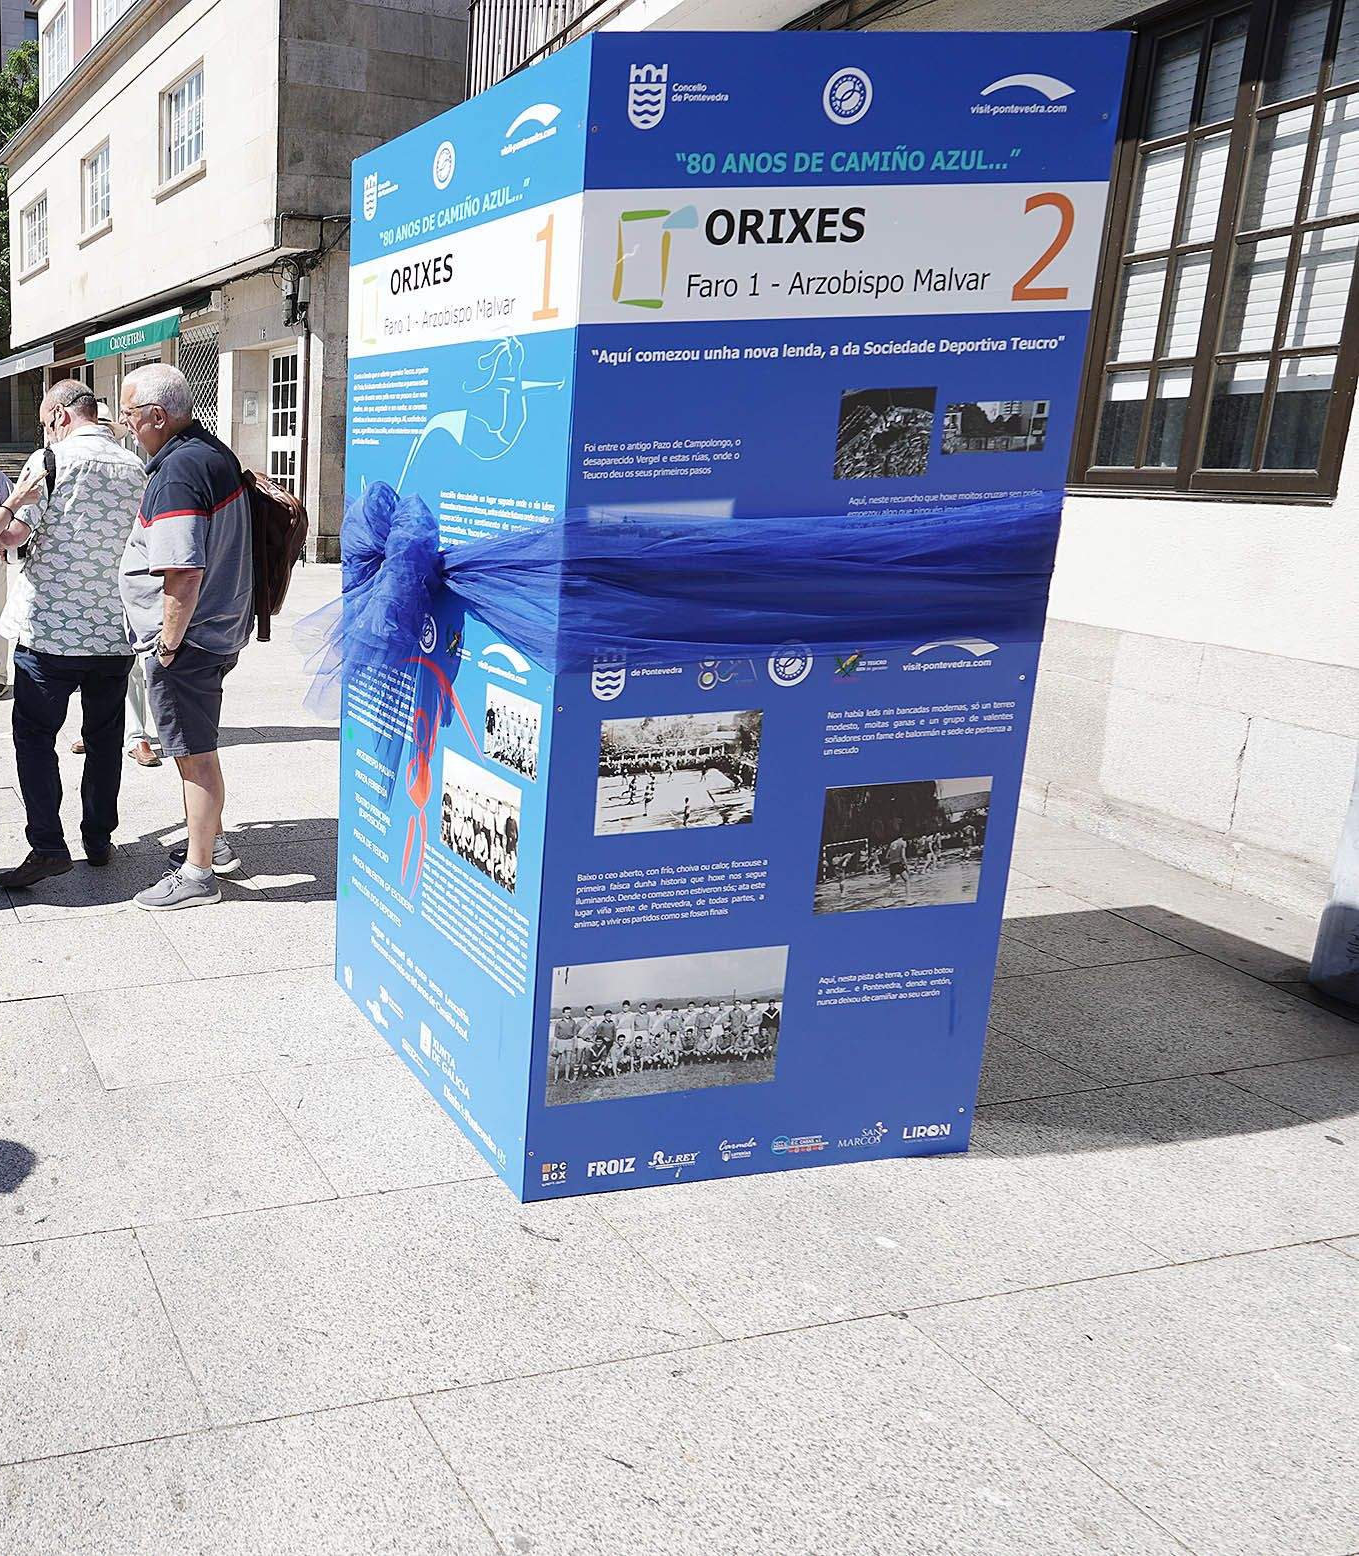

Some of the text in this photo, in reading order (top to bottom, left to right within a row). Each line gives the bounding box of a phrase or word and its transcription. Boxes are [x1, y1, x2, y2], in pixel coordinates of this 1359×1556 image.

[672, 83, 707, 92] Concello
[671, 93, 729, 102] de Pontevedra
[970, 104, 1067, 116] visit-pontevedra.com
[722, 152, 787, 173] ANOS
[793, 152, 825, 173] DE
[830, 145, 925, 172] CAMIÑO
[395, 220, 421, 244] ANOS
[422, 213, 436, 233] DE
[437, 195, 480, 228] CAMIÑO
[704, 206, 866, 246] ORIXES
[1011, 191, 1075, 302] 2
[390, 253, 453, 295] ORIXES
[532, 213, 559, 321] 1
[686, 274, 738, 299] Faro
[749, 273, 760, 296] 1
[788, 270, 904, 300] Arzobispo
[914, 267, 991, 292] Malvar
[383, 296, 516, 336] Faro 1 Arzobispo Malvar
[635, 349, 700, 362] comezou
[704, 345, 739, 360] unha
[744, 346, 779, 359] nova
[783, 343, 826, 359] lenda,
[830, 345, 838, 356] a
[842, 342, 859, 356] da
[863, 339, 936, 356] Sociedade
[939, 337, 1007, 355] Deportiva
[584, 443, 596, 452] Foi
[597, 444, 619, 452] entre
[626, 442, 651, 452] antigo
[652, 441, 671, 450] Pazo
[672, 440, 683, 449] de
[683, 439, 733, 449] Campolongo,
[583, 456, 634, 467] desaparecido
[636, 454, 660, 465] Vergel
[669, 454, 690, 462] estas
[691, 452, 711, 462] rúas,
[712, 452, 732, 461] onde
[582, 467, 712, 480] Teucro deu os seus primeiros pasos
[848, 495, 867, 506] Aquí,
[868, 496, 889, 504] neste
[890, 494, 923, 503] recuncho
[924, 495, 939, 503] que
[940, 493, 957, 501] hoxe
[958, 492, 983, 500] moitos
[983, 491, 1008, 499] cruzan
[1009, 490, 1022, 498] sen
[630, 667, 683, 677] de Pontevedra
[902, 658, 992, 673] visit-pontevedra.com
[827, 701, 1016, 719] Non había leds nin bancadas modernas, só un terreo
[825, 723, 860, 731] modesto,
[864, 720, 889, 729] moitas
[893, 718, 916, 728] ganas
[942, 716, 965, 725] grupo
[968, 714, 979, 722] de
[983, 713, 1014, 721] valentes
[823, 746, 859, 756] un escudo
[577, 873, 597, 882] Baixo
[604, 872, 618, 880] ceo
[619, 869, 645, 879] aberto,
[645, 868, 660, 876] con
[660, 866, 675, 875] frío,
[676, 864, 699, 873] choiva
[700, 863, 710, 871] ou
[711, 862, 730, 870] calor,
[731, 860, 762, 869] forxouse
[576, 884, 606, 895] primeira
[634, 880, 657, 889] dunha
[660, 877, 687, 887] historia
[690, 876, 704, 885] que
[707, 874, 726, 882] hoxe
[745, 871, 767, 880] segue
[575, 895, 617, 905] iluminando.
[617, 893, 641, 901] Dende
[647, 891, 674, 899] comezo
[690, 886, 722, 895] estiveron
[722, 884, 738, 892] sós;
[737, 883, 750, 891] ata
[574, 909, 593, 918] lugar
[596, 906, 612, 915] viña
[615, 904, 635, 913] xente
[638, 903, 648, 911] de
[651, 899, 693, 910] Pontevedra,
[696, 898, 706, 906] de
[708, 896, 729, 905] todas
[731, 894, 756, 904] partes,
[818, 976, 837, 985] Aquí,
[857, 973, 874, 983] pista
[874, 972, 884, 980] de
[884, 971, 903, 979] terra,
[910, 968, 933, 976] Teucro
[933, 967, 954, 975] botou
[432, 1036, 456, 1071] XUNTA
[431, 1050, 471, 1100] DE GALICIA
[861, 1128, 882, 1138] SAN
[903, 1123, 951, 1139] LIRON
[718, 1137, 757, 1152] Carmela
[837, 1135, 882, 1147] MARCOS
[551, 1162, 567, 1172] PC
[587, 1157, 636, 1178] FROIZ
[542, 1172, 567, 1182] BOX
